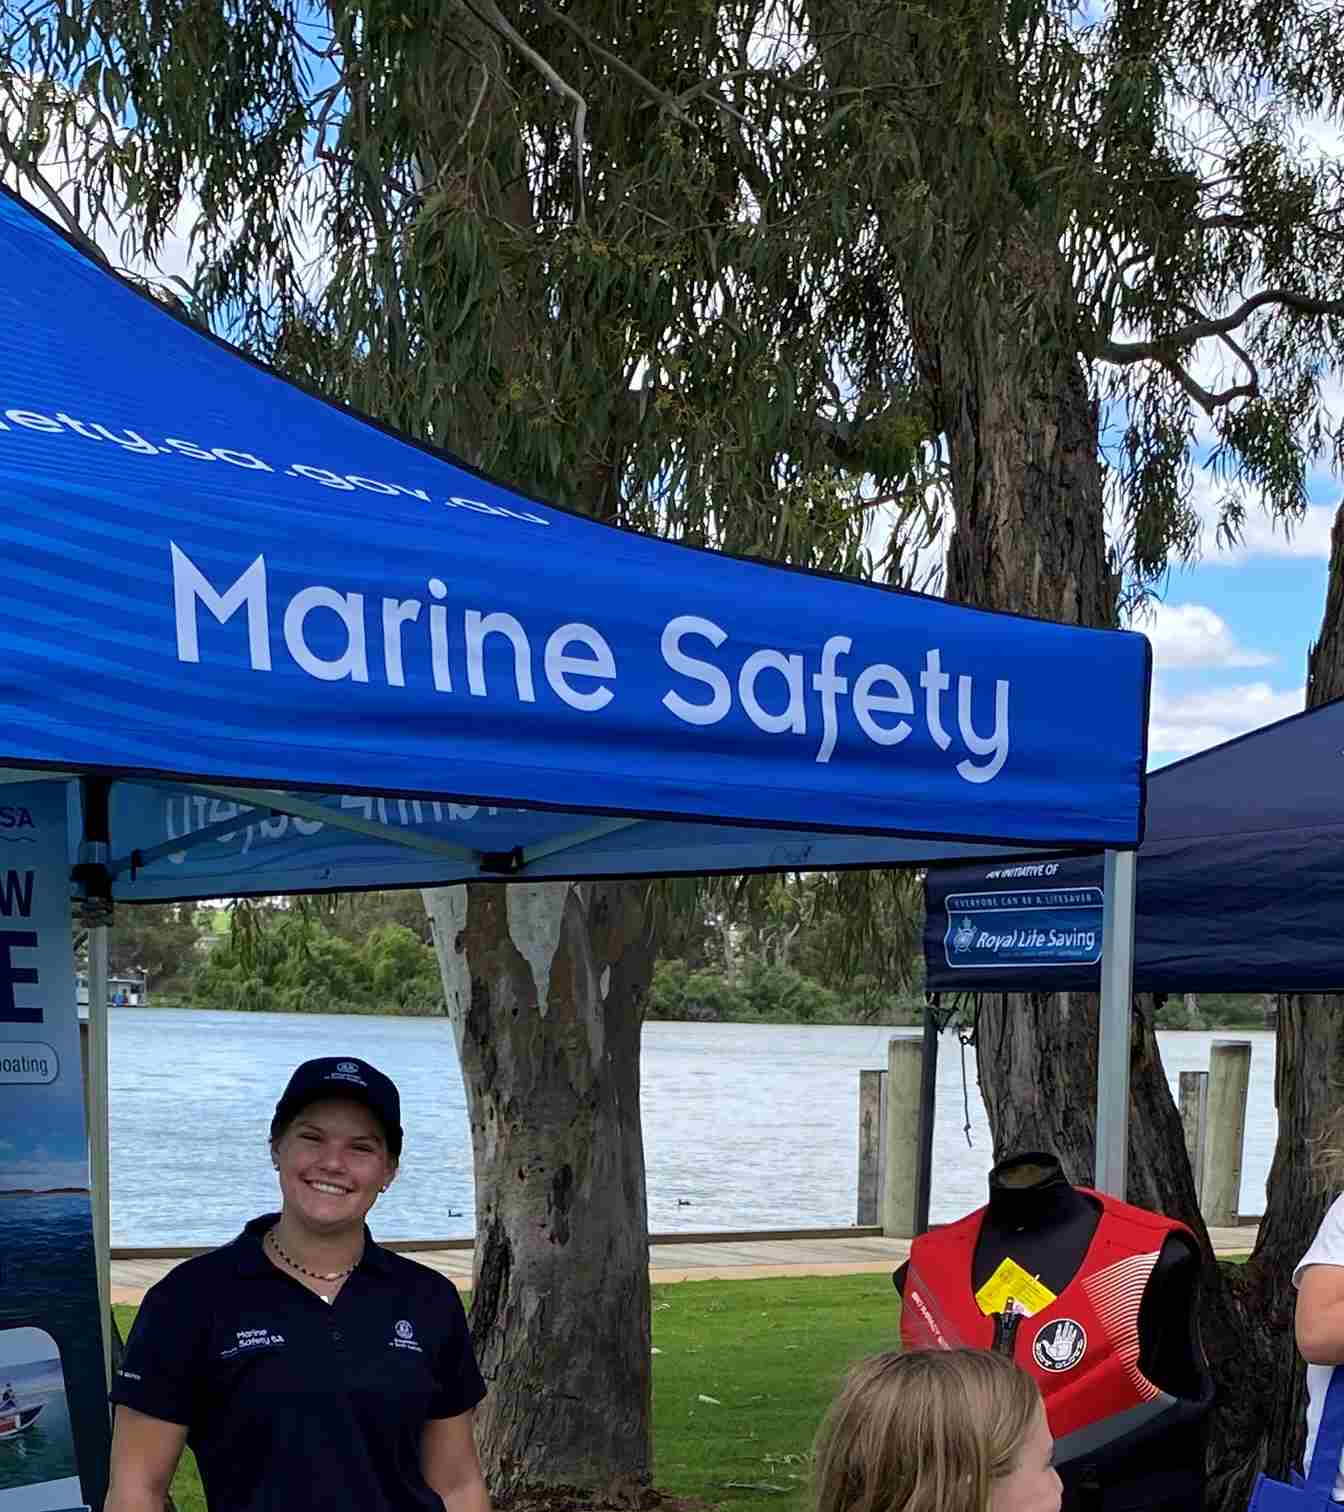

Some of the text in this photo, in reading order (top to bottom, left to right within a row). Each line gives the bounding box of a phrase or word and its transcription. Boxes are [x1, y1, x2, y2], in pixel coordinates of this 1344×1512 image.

[170, 541, 1010, 783] Marine Safety
[0, 807, 35, 829] SA
[1046, 864, 1060, 877] OF
[976, 928, 1095, 952] Royal Life Saving
